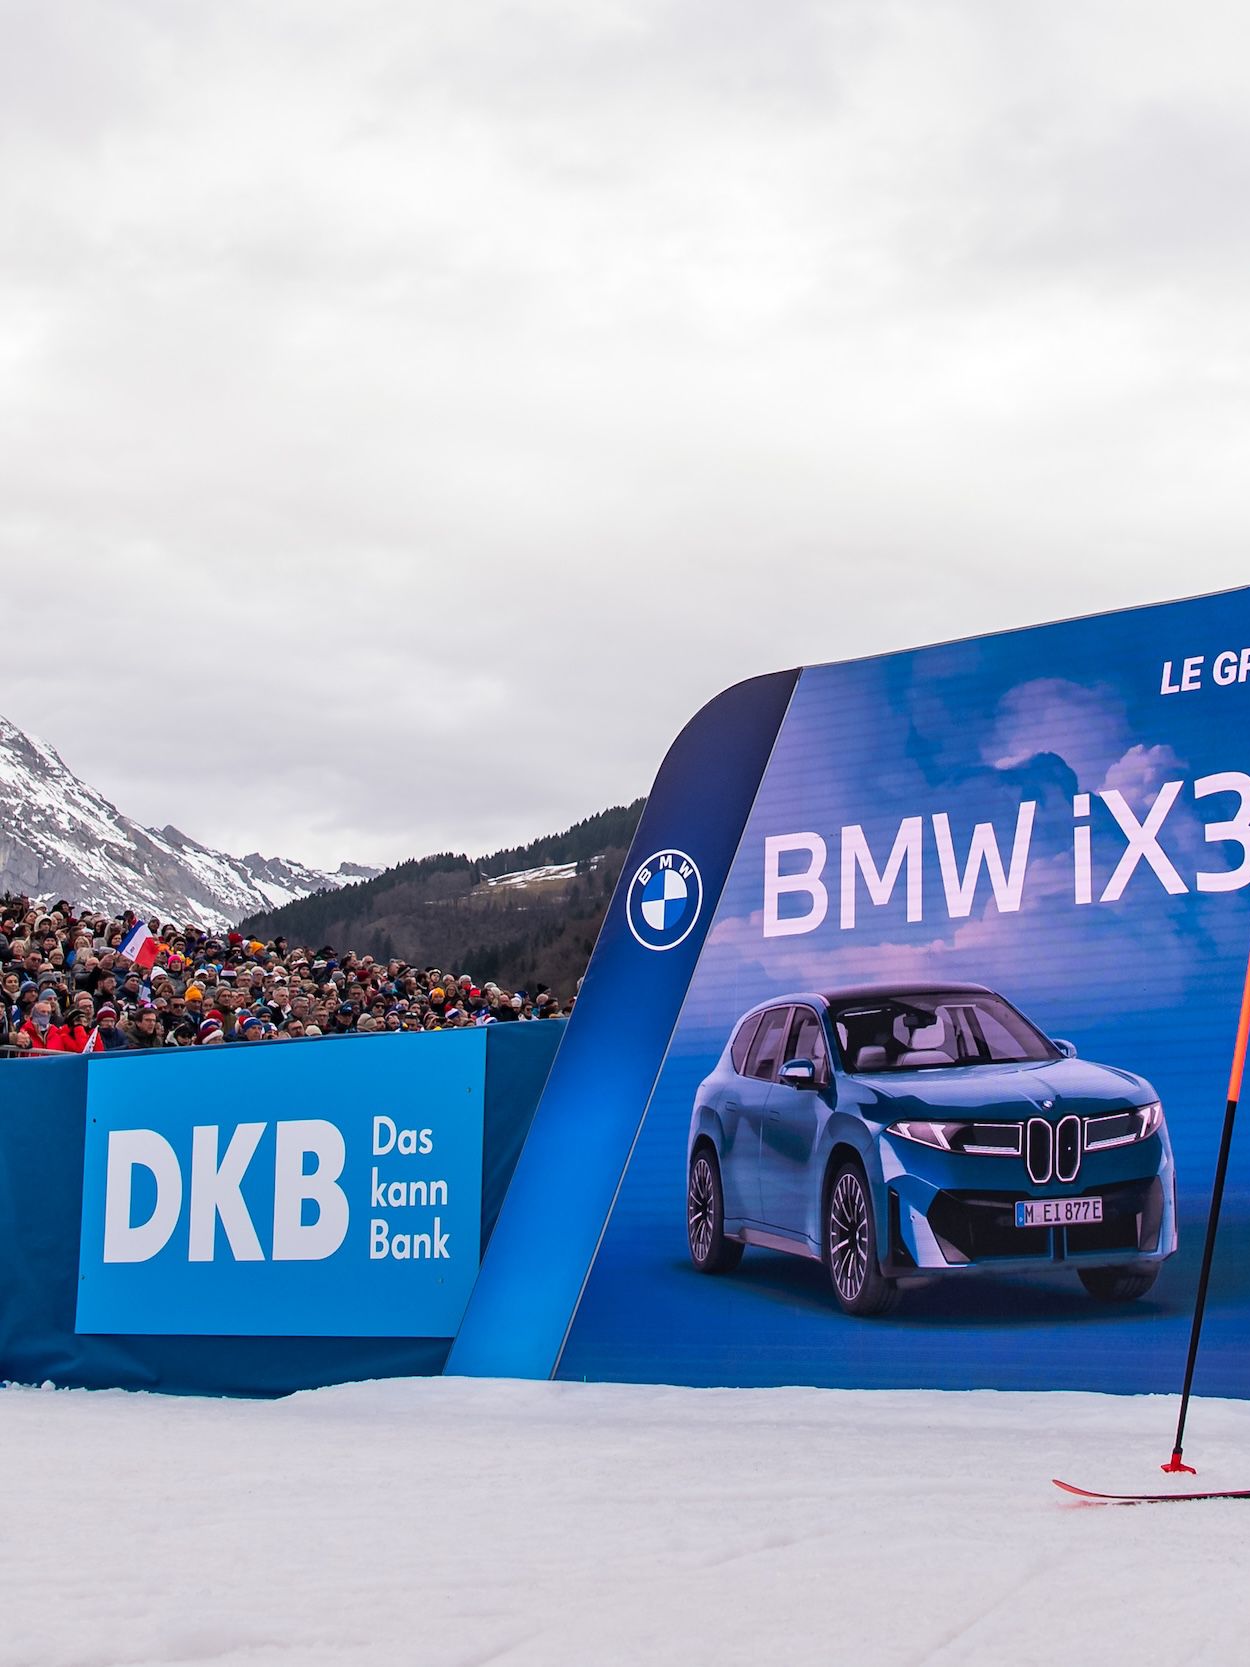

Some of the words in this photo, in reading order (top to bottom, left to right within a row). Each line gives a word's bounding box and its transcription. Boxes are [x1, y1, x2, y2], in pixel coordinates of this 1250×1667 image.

[1160, 656, 1204, 695] LE
[637, 854, 694, 887] BMW
[764, 800, 1037, 938] BMW
[371, 1116, 433, 1156] Das
[103, 1119, 350, 1264] DKB
[370, 1168, 448, 1209] kann
[370, 1217, 451, 1260] Bank
